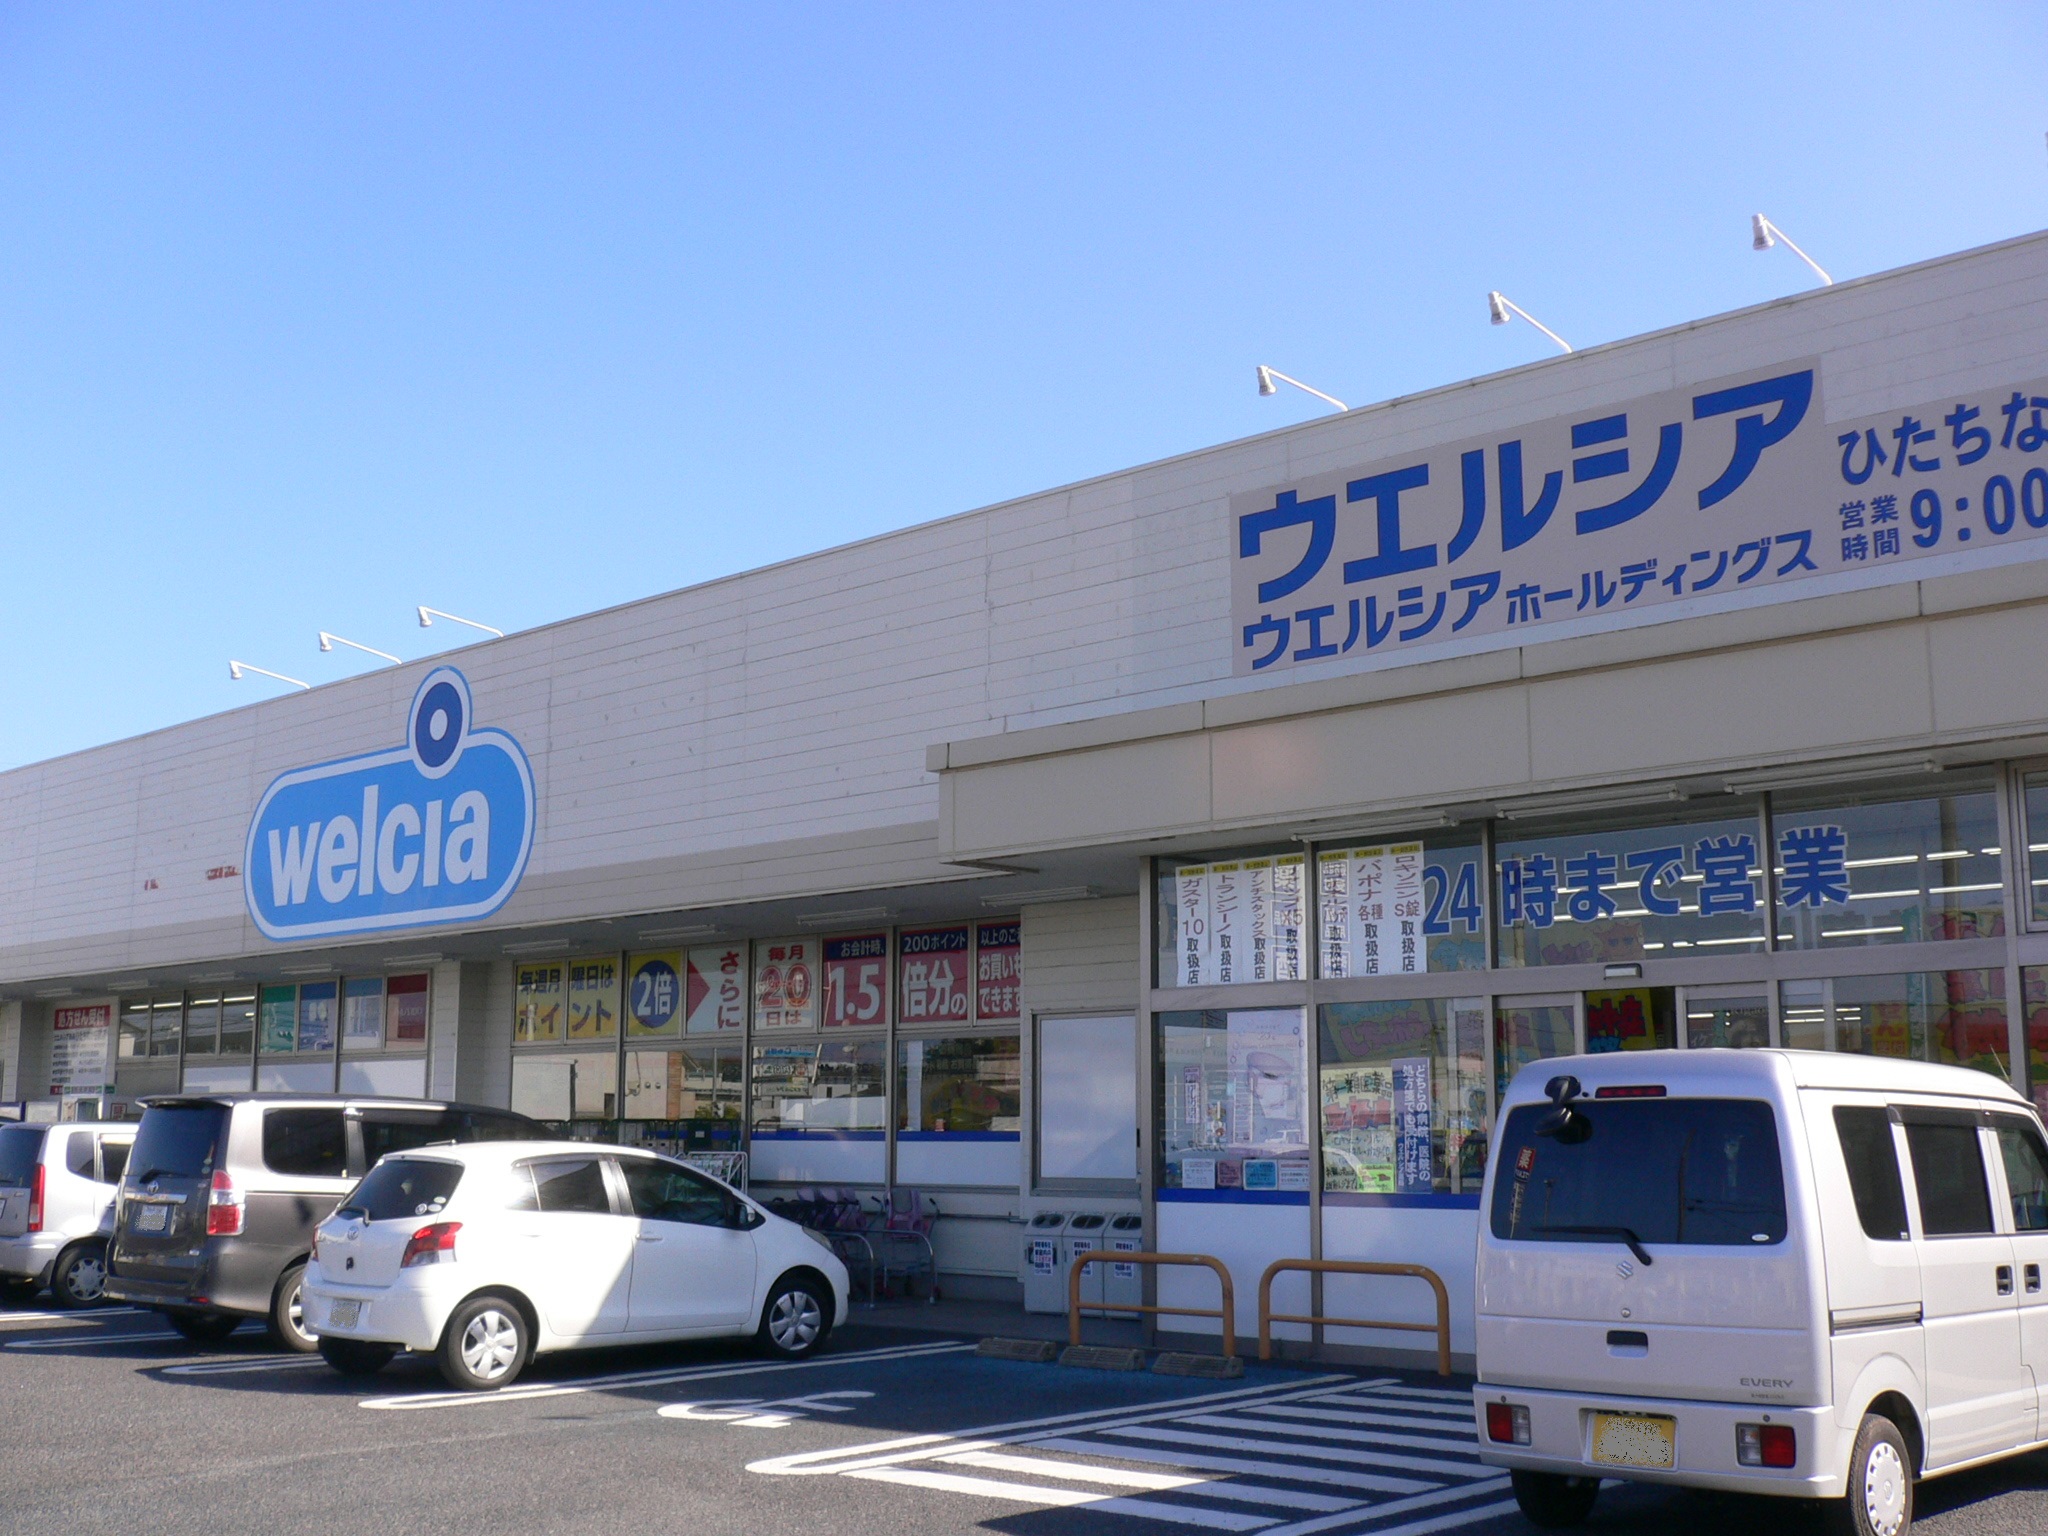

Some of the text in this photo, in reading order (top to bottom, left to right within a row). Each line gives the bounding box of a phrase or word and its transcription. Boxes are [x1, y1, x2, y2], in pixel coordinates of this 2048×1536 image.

[1838, 392, 2048, 486] ひたちな
[1239, 368, 1814, 604] ウエルシア
[1910, 467, 2048, 548] 9:00
[1839, 495, 1899, 531] 営業
[1841, 527, 1900, 562] 時間
[1242, 530, 1819, 670] ウエルシアホールディングス
[268, 784, 490, 907] welcia
[1421, 823, 1852, 937] 24時まで営業
[767, 943, 804, 963] 毎月
[903, 930, 967, 953] 200ポイント
[637, 970, 673, 1017] 2倍
[717, 950, 743, 1030] さらに
[758, 963, 812, 1009] 20
[830, 963, 880, 1021] 1.5
[902, 955, 967, 1018] 倍分の
[518, 998, 612, 1035] ポイント
[765, 1010, 803, 1027] 日は
[1740, 1377, 1793, 1388] EVERY
